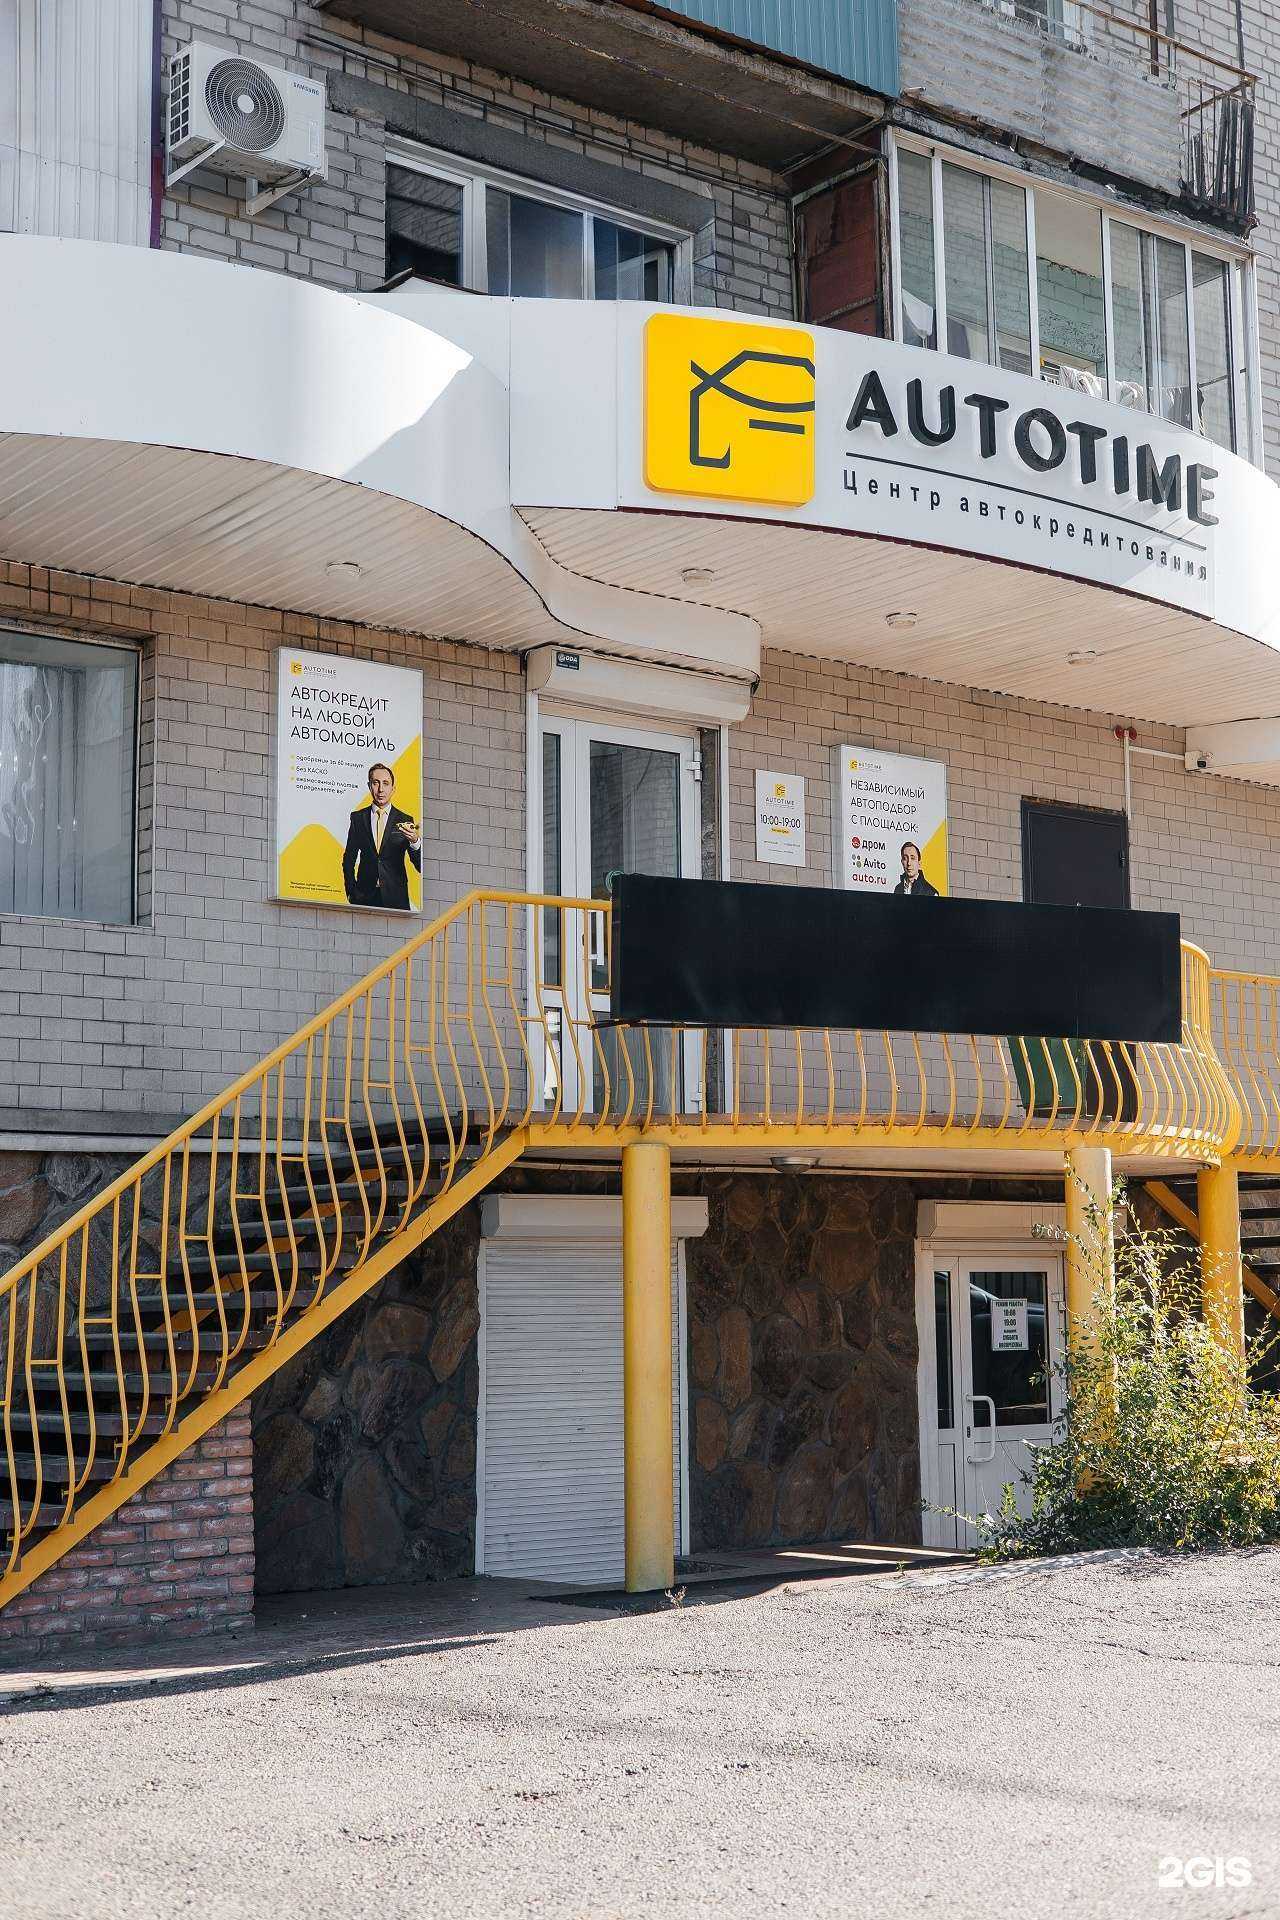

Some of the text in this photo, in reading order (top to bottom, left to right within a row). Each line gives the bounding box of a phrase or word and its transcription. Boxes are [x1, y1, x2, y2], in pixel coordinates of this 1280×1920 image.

[845, 370, 1219, 526] AUTOTIME
[843, 468, 1207, 580] Центр автокредитования
[303, 665, 337, 676] AUTOTIME
[291, 686, 390, 712] АВТОКРЕДИТ
[292, 705, 376, 730] НА ЛЮБОЙ
[291, 725, 396, 752] АВТОМОБИЛЬ
[850, 779, 925, 800] НЕЗАВИСИМЫЙ
[765, 797, 795, 806] AUTOTIME
[850, 796, 917, 815] АВТОПОДБОР
[760, 813, 801, 829] 10:00-19:00
[851, 814, 858, 825] С
[862, 840, 886, 851] дром
[863, 857, 886, 870] Avito
[852, 873, 887, 885] auto.ru
